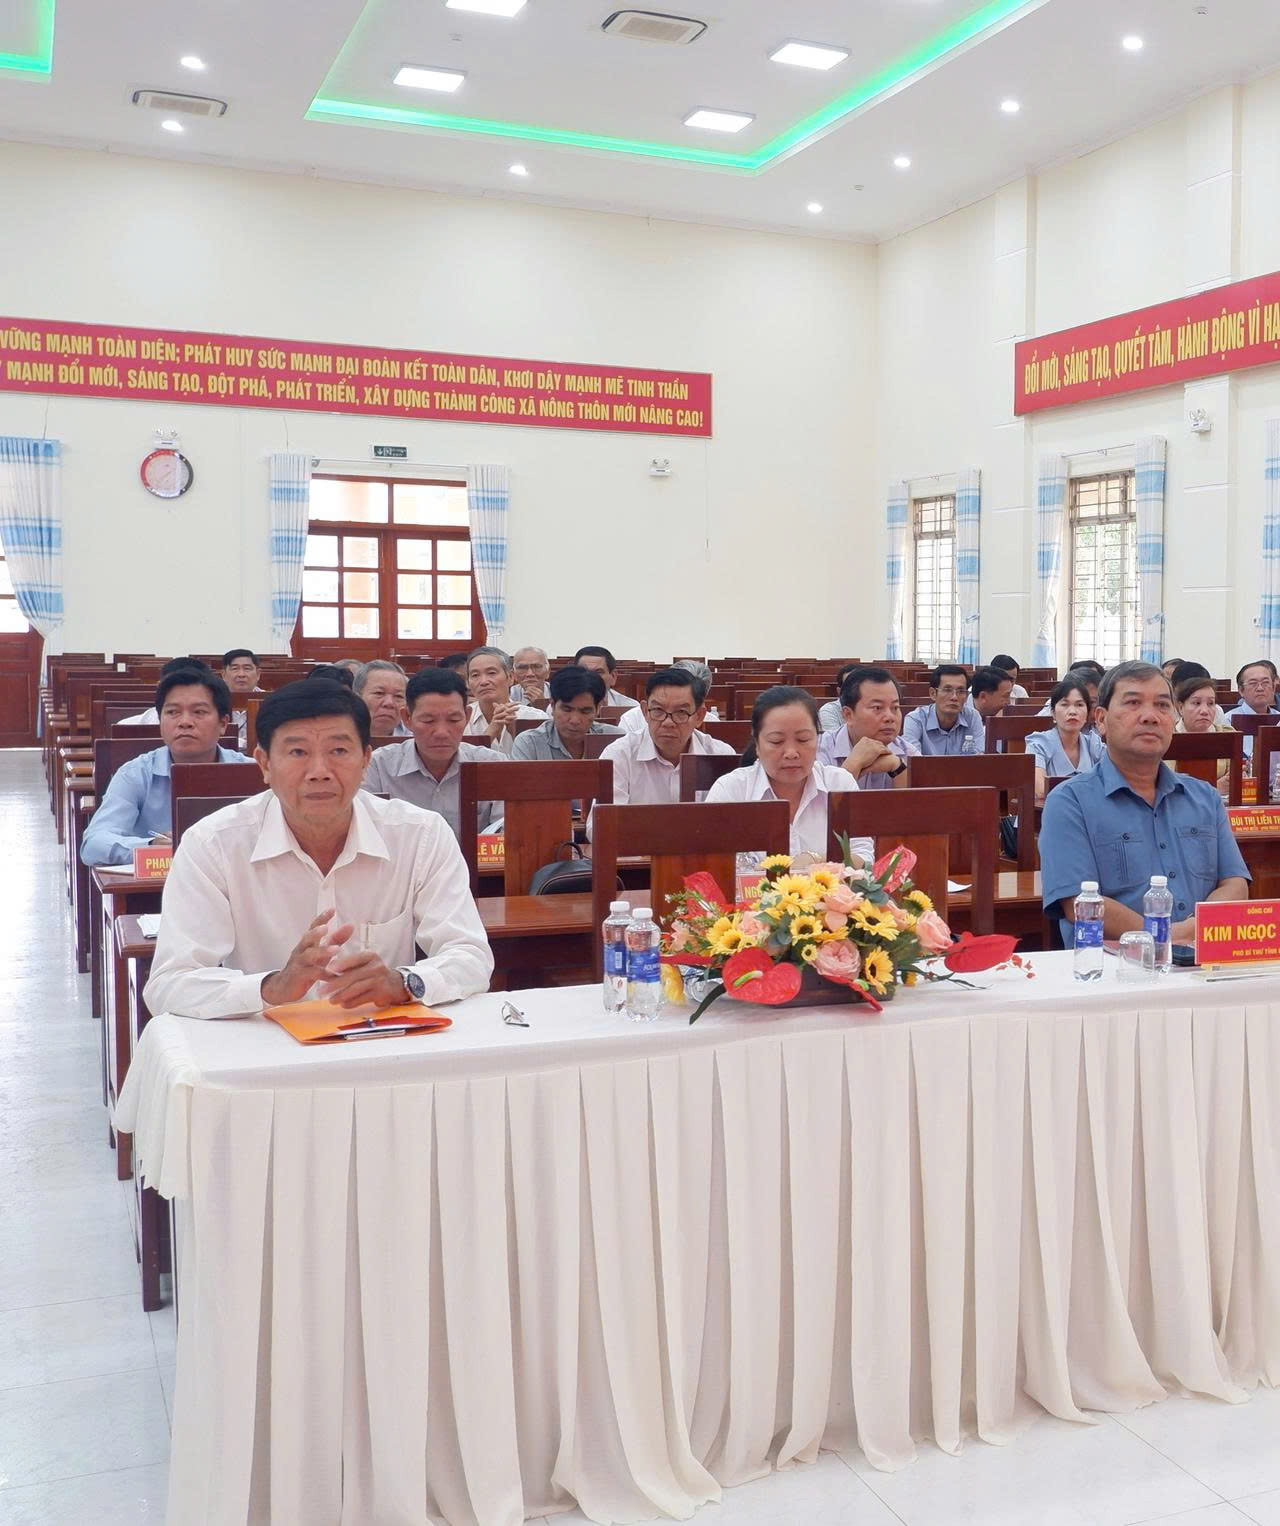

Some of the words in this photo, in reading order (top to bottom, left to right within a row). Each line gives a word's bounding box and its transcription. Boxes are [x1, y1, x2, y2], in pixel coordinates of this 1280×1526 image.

[0, 326, 42, 352] VỮNG
[45, 332, 93, 359] MẠNH
[95, 335, 137, 359] TOÀN
[140, 337, 181, 365] DIỆN;
[183, 342, 223, 365] PHÁT
[225, 346, 255, 368] HUY
[257, 346, 287, 371] SỨC
[289, 351, 333, 376] MẠNH
[335, 355, 360, 380] ĐẠI
[361, 356, 401, 379] ĐOÀN
[403, 356, 429, 381] KẾT
[430, 362, 467, 384] TOÀN
[469, 363, 501, 388] DÂN,
[503, 369, 534, 390] KHƠI
[536, 369, 562, 394] DẬY
[564, 373, 602, 397] MẠNH
[604, 375, 625, 396] MẼ
[626, 378, 655, 398] TINH
[656, 379, 689, 401] THẦN
[1023, 349, 1041, 396] ĐỔI
[1040, 350, 1062, 392] MỚI,
[1062, 345, 1090, 387] SÁNG
[1090, 343, 1113, 388] TẠO,
[1113, 326, 1147, 380] QUYẾT
[1147, 323, 1175, 369] TÂM,
[1176, 316, 1210, 362] HÀNH
[1210, 307, 1246, 361] ĐỘNG
[1247, 298, 1261, 346] VÌ
[6, 360, 55, 386] MẠNH
[57, 358, 85, 385] ĐỔI
[88, 363, 124, 390] MỚI,
[127, 367, 169, 391] SÁNG
[171, 372, 204, 396] TẠO,
[207, 371, 236, 399] ĐỘT
[238, 375, 273, 401] PHÁ,
[275, 378, 313, 401] PHÁT
[315, 377, 360, 406] TRIỂN,
[363, 383, 390, 406] XÂY
[393, 387, 431, 412] DỰNG
[432, 389, 477, 413] THÀNH
[479, 393, 516, 415] CÔNG
[518, 395, 537, 417] XÃ
[538, 396, 575, 419] NÔNG
[576, 399, 610, 421] THÔN
[612, 401, 637, 423] MỚI
[639, 403, 674, 426] NÂNG
[675, 408, 704, 428] CAO!
[1203, 926, 1232, 942] KIM
[1236, 923, 1277, 943] NGỌC
